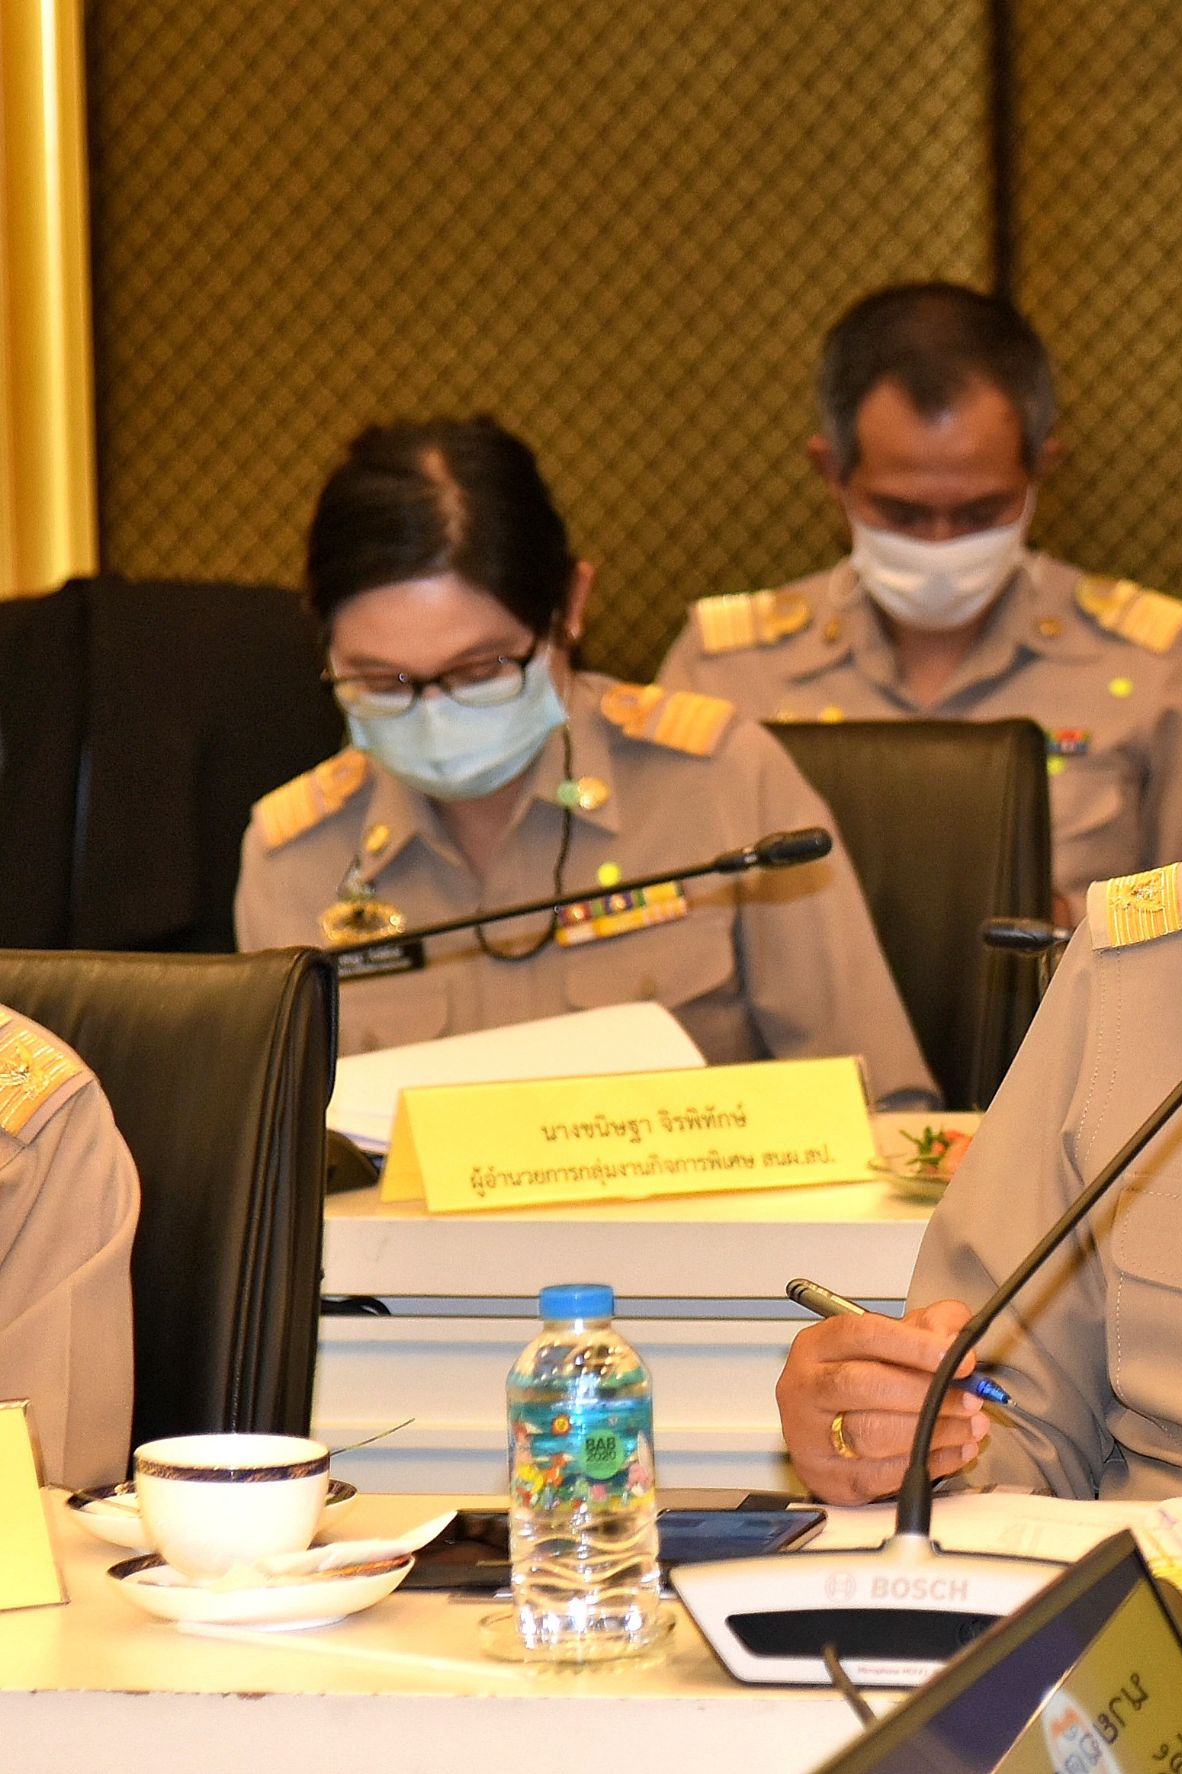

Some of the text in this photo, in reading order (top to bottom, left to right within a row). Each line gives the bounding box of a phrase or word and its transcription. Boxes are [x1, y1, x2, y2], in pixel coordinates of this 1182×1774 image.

[585, 1437, 617, 1452] BAB
[586, 1451, 617, 1462] 2020
[870, 1575, 970, 1602] BOSCH
